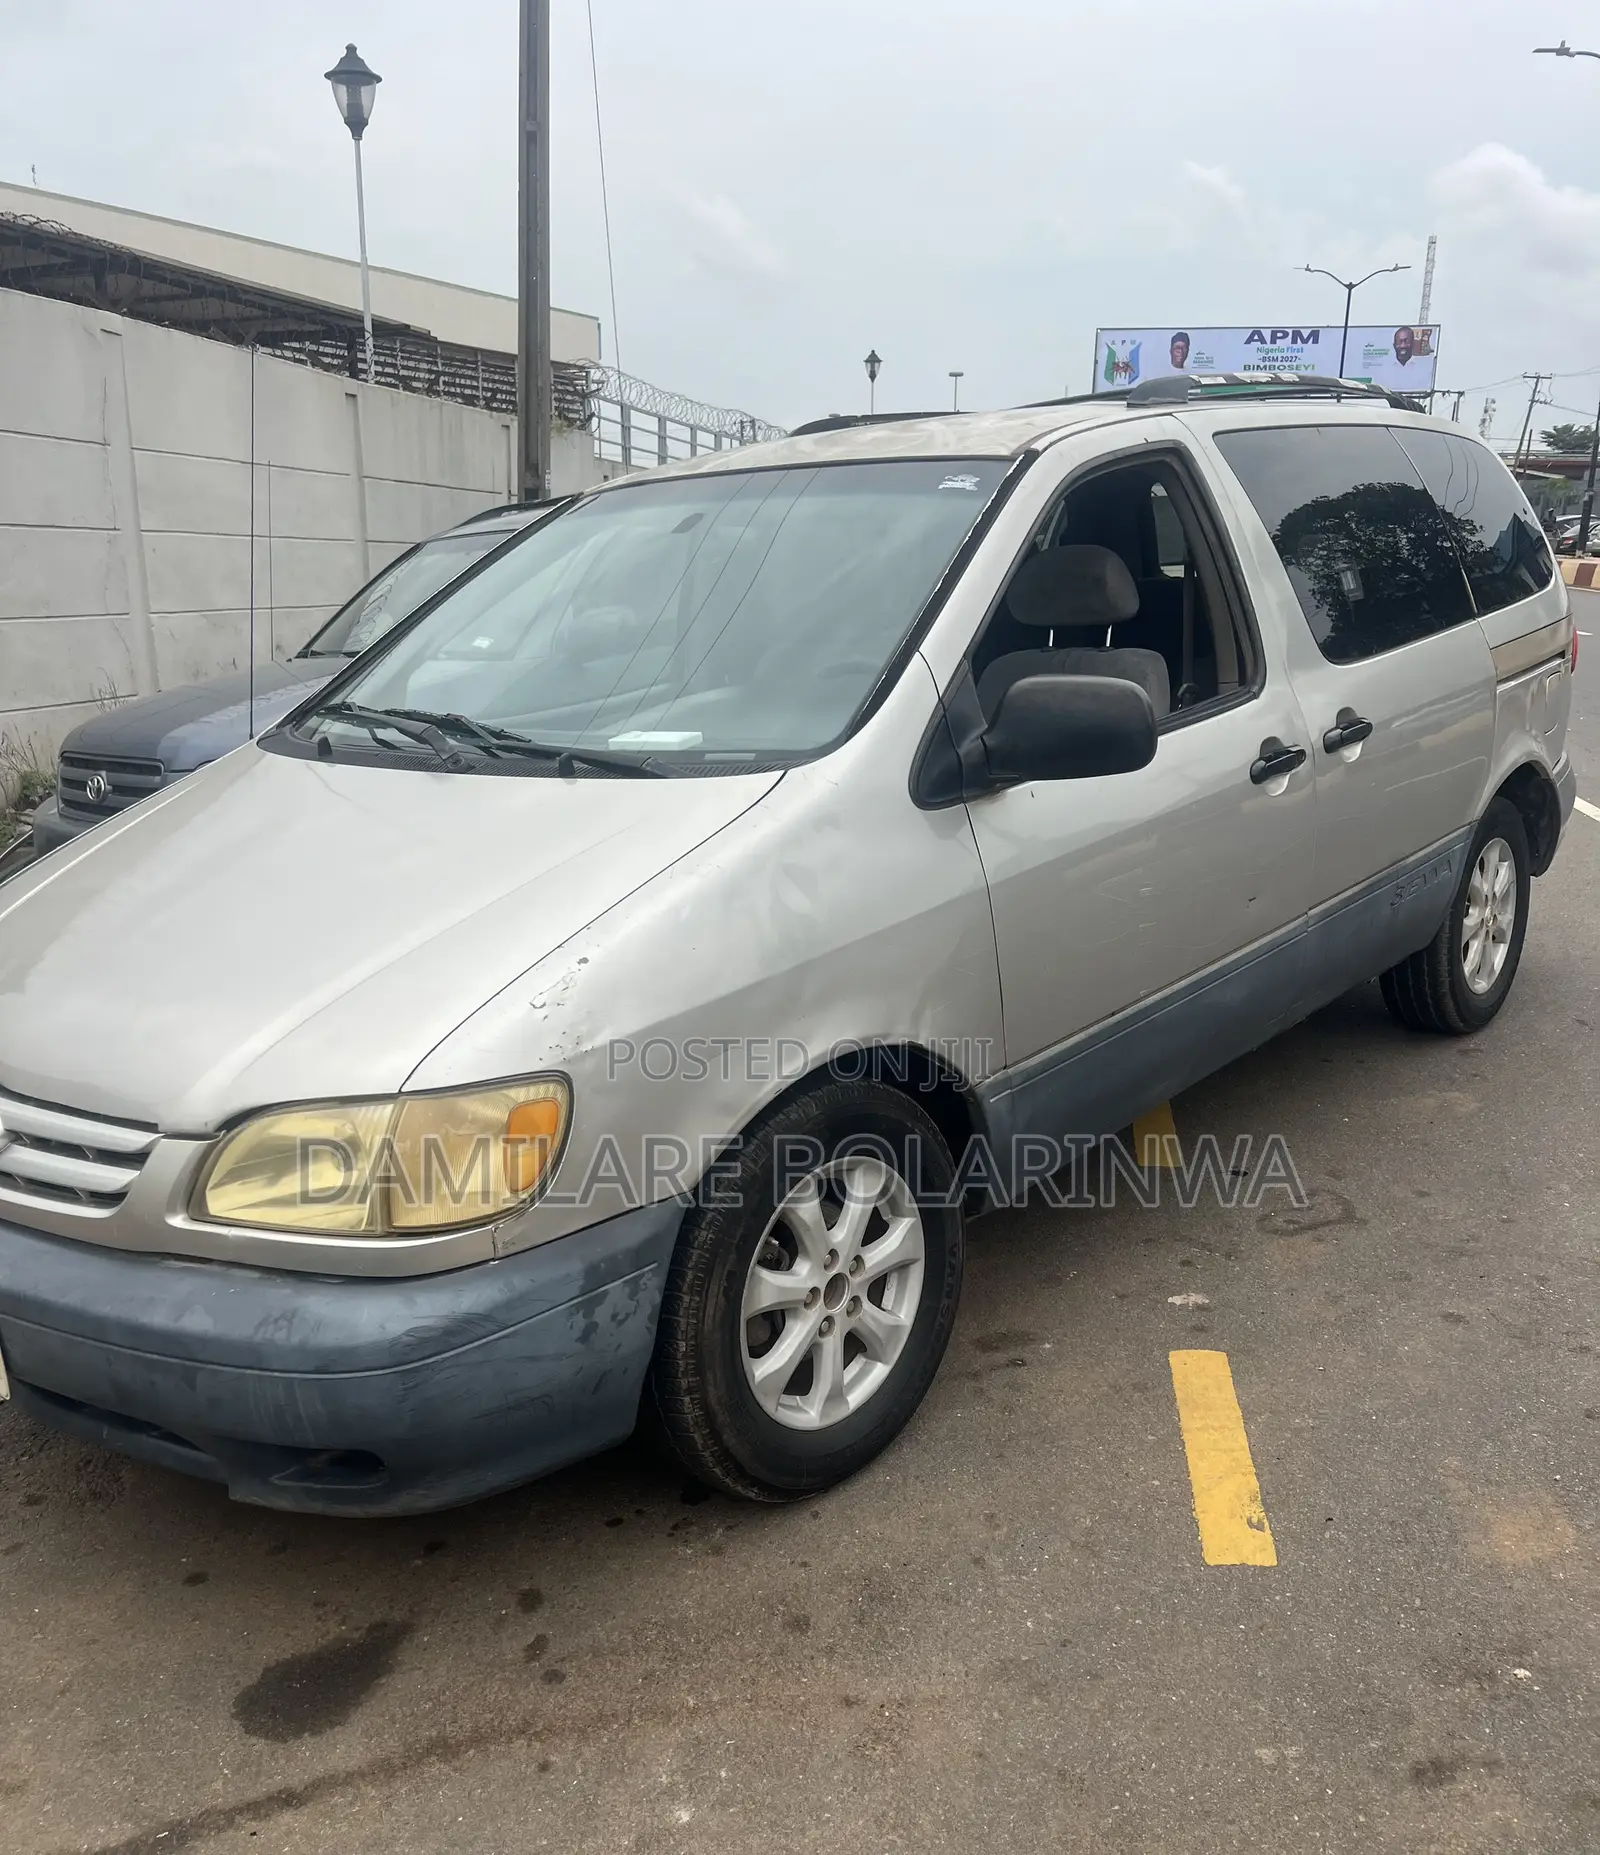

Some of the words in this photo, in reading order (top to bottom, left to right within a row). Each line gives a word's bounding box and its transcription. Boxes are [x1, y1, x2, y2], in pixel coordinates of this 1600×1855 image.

[1243, 329, 1320, 345] APM
[1256, 346, 1285, 355] Nigeria
[1286, 346, 1304, 354] First
